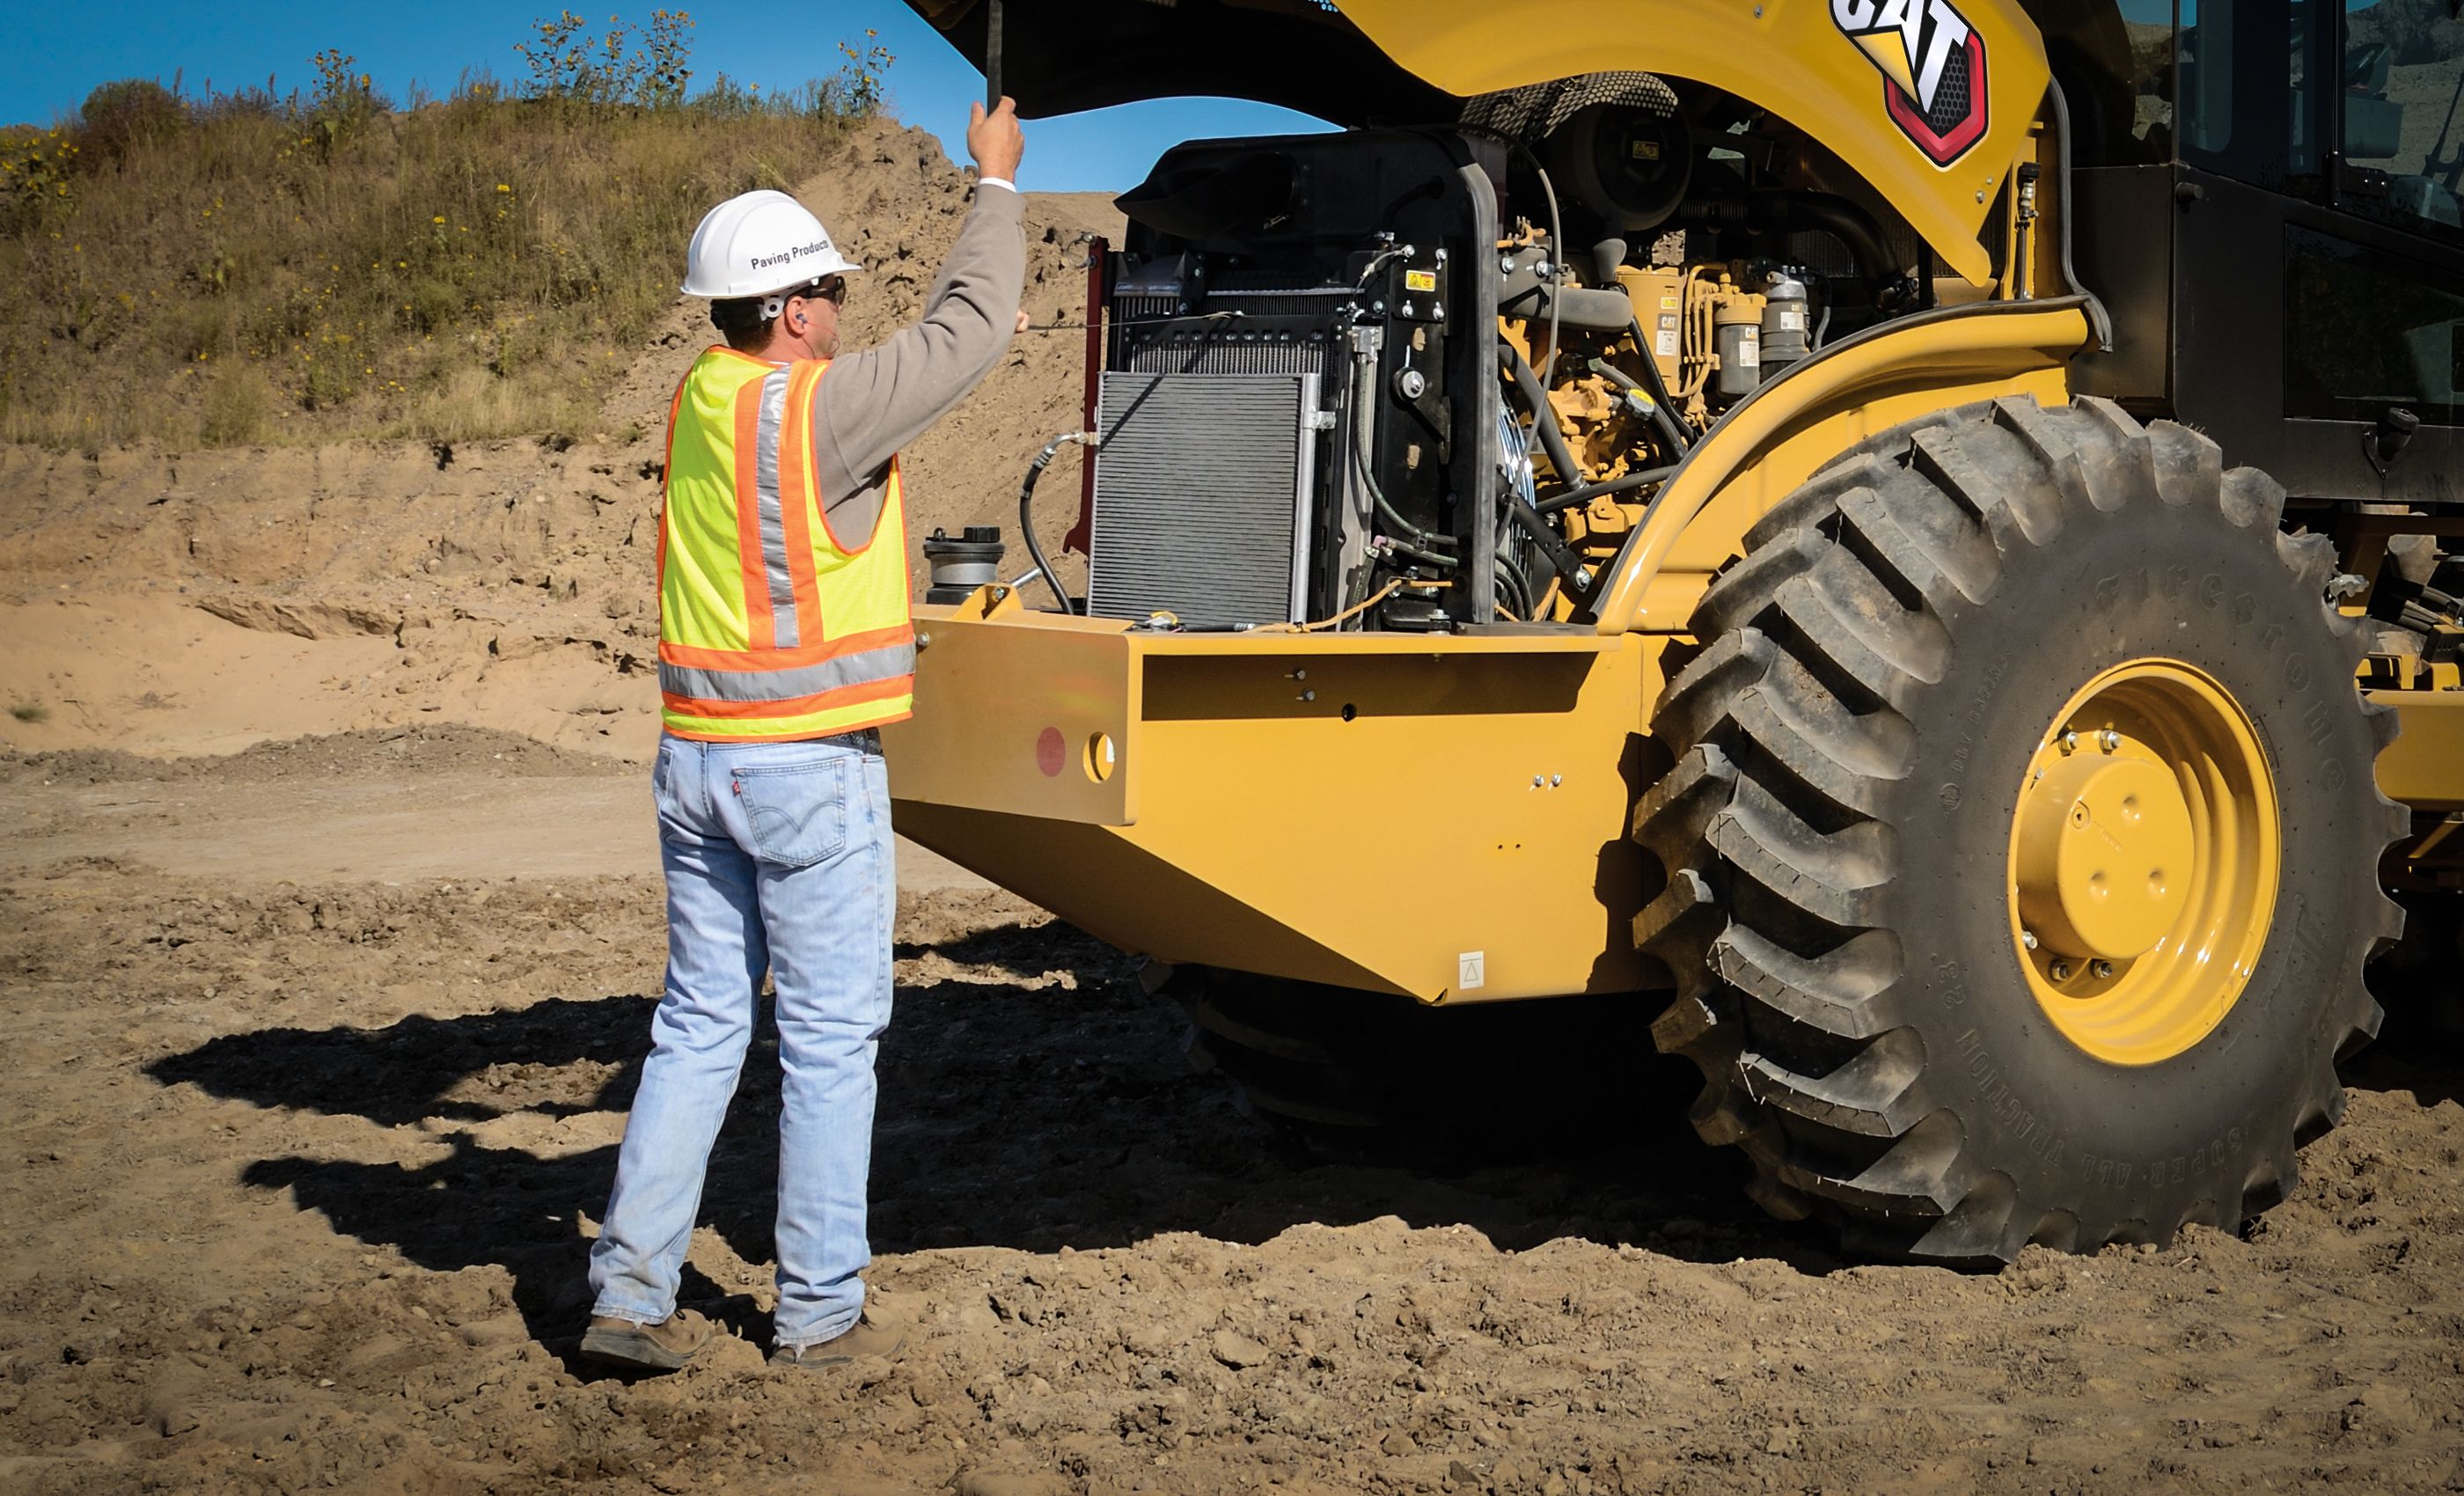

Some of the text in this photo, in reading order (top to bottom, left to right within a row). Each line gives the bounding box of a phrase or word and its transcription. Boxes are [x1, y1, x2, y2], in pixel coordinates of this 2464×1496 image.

[751, 239, 829, 270] Paving Products
[1661, 316, 1676, 327] CAT
[2094, 564, 2347, 794] Firestone
[1956, 1028, 2065, 1168] TRACTION
[2081, 1154, 2132, 1188] ALL
[2150, 1127, 2243, 1188] SUPER
